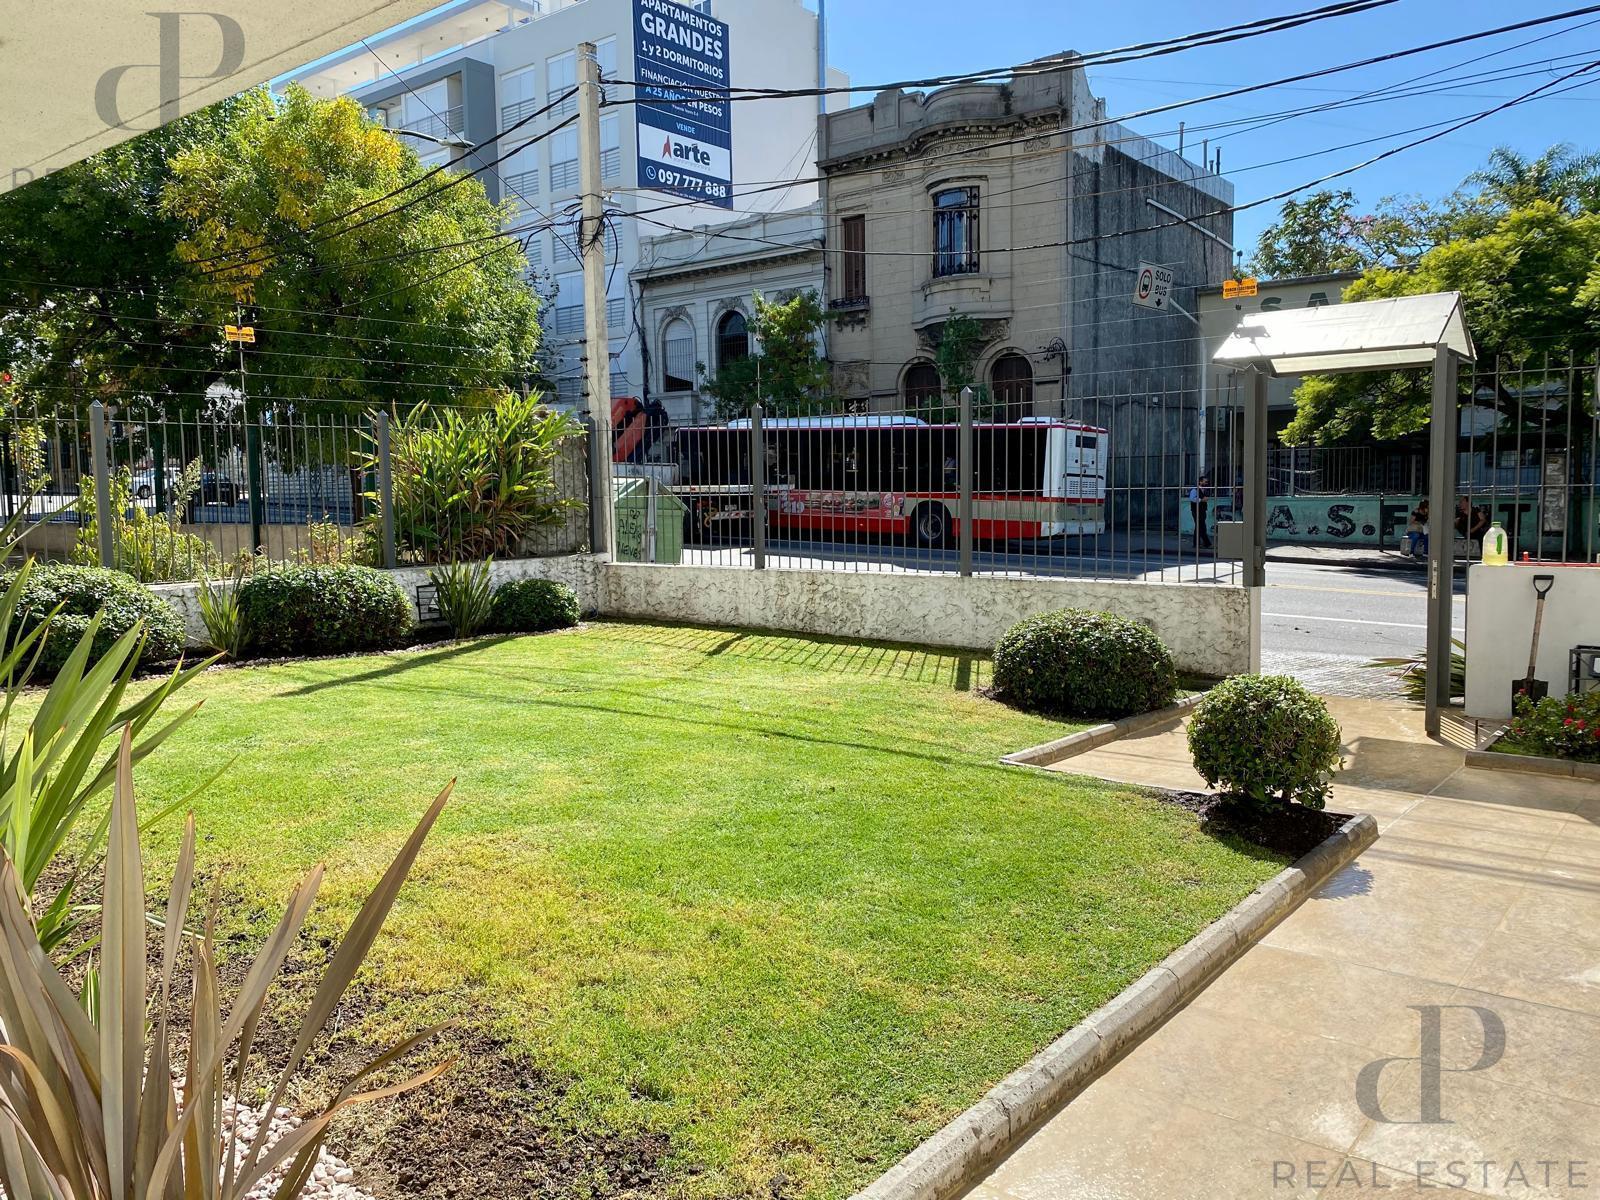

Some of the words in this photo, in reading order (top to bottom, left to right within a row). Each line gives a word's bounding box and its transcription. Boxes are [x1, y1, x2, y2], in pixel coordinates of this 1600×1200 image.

[641, 0, 722, 36] APARTAMENTOS
[641, 12, 723, 60] GRANDES
[642, 40, 648, 51] 1
[649, 44, 655, 56] y
[656, 45, 662, 56] 2
[663, 47, 723, 79] DORMITORIOS
[653, 87, 663, 97] 25
[699, 101, 723, 117] PESOS
[675, 122, 696, 135] VENDE
[673, 142, 711, 166] arte
[658, 168, 681, 187] 097
[682, 175, 703, 192] 777
[705, 181, 726, 198] 888
[1155, 270, 1172, 284] SOLO
[1155, 285, 1168, 297] BUS
